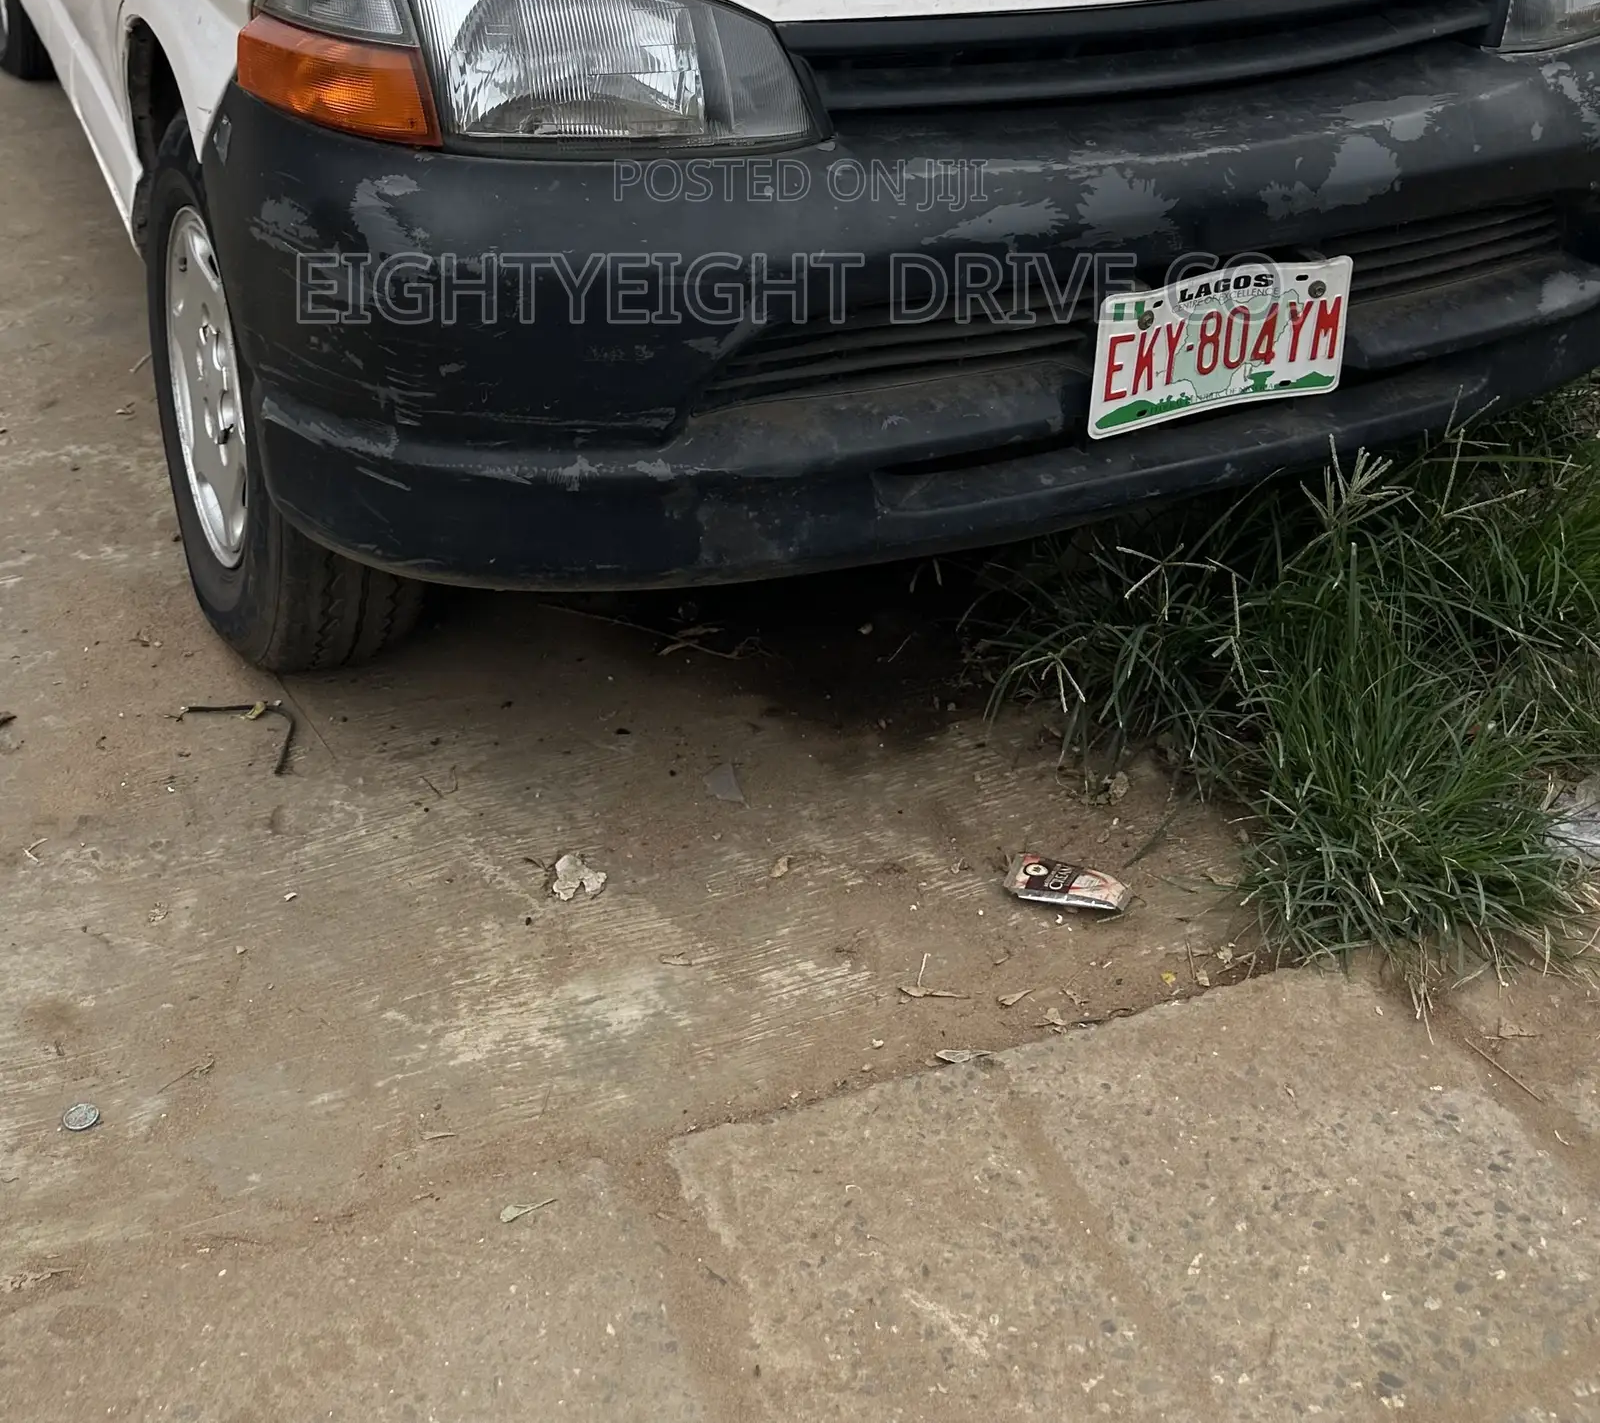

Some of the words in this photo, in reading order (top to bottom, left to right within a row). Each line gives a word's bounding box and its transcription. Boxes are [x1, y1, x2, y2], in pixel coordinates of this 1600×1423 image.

[1177, 273, 1275, 304] LAGOS
[1219, 286, 1281, 301] EXCELLENCE
[1103, 294, 1343, 403] EKY-804YM
